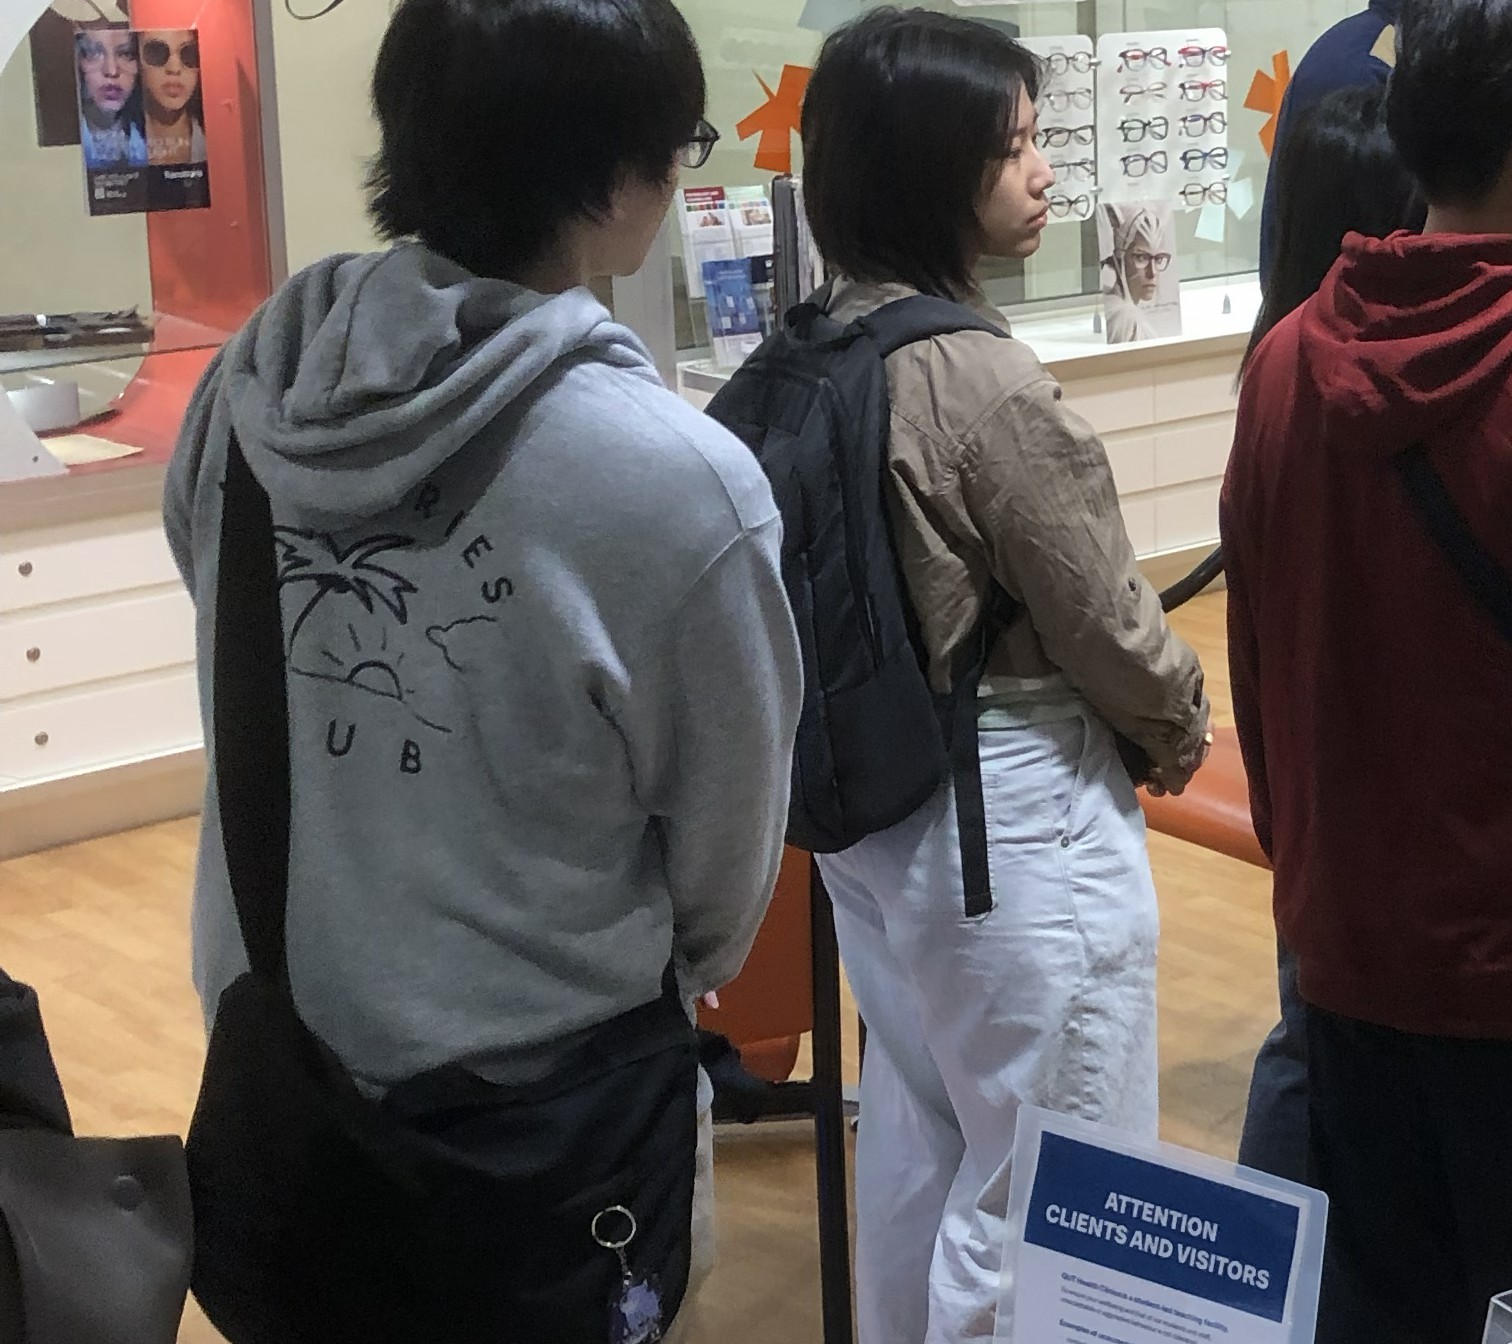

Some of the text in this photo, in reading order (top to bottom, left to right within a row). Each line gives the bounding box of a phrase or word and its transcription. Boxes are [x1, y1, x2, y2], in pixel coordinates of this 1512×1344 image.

[1045, 1204, 1270, 1290] CLIENTS AND VISITORS
[1104, 1192, 1219, 1242] ATTENTION
